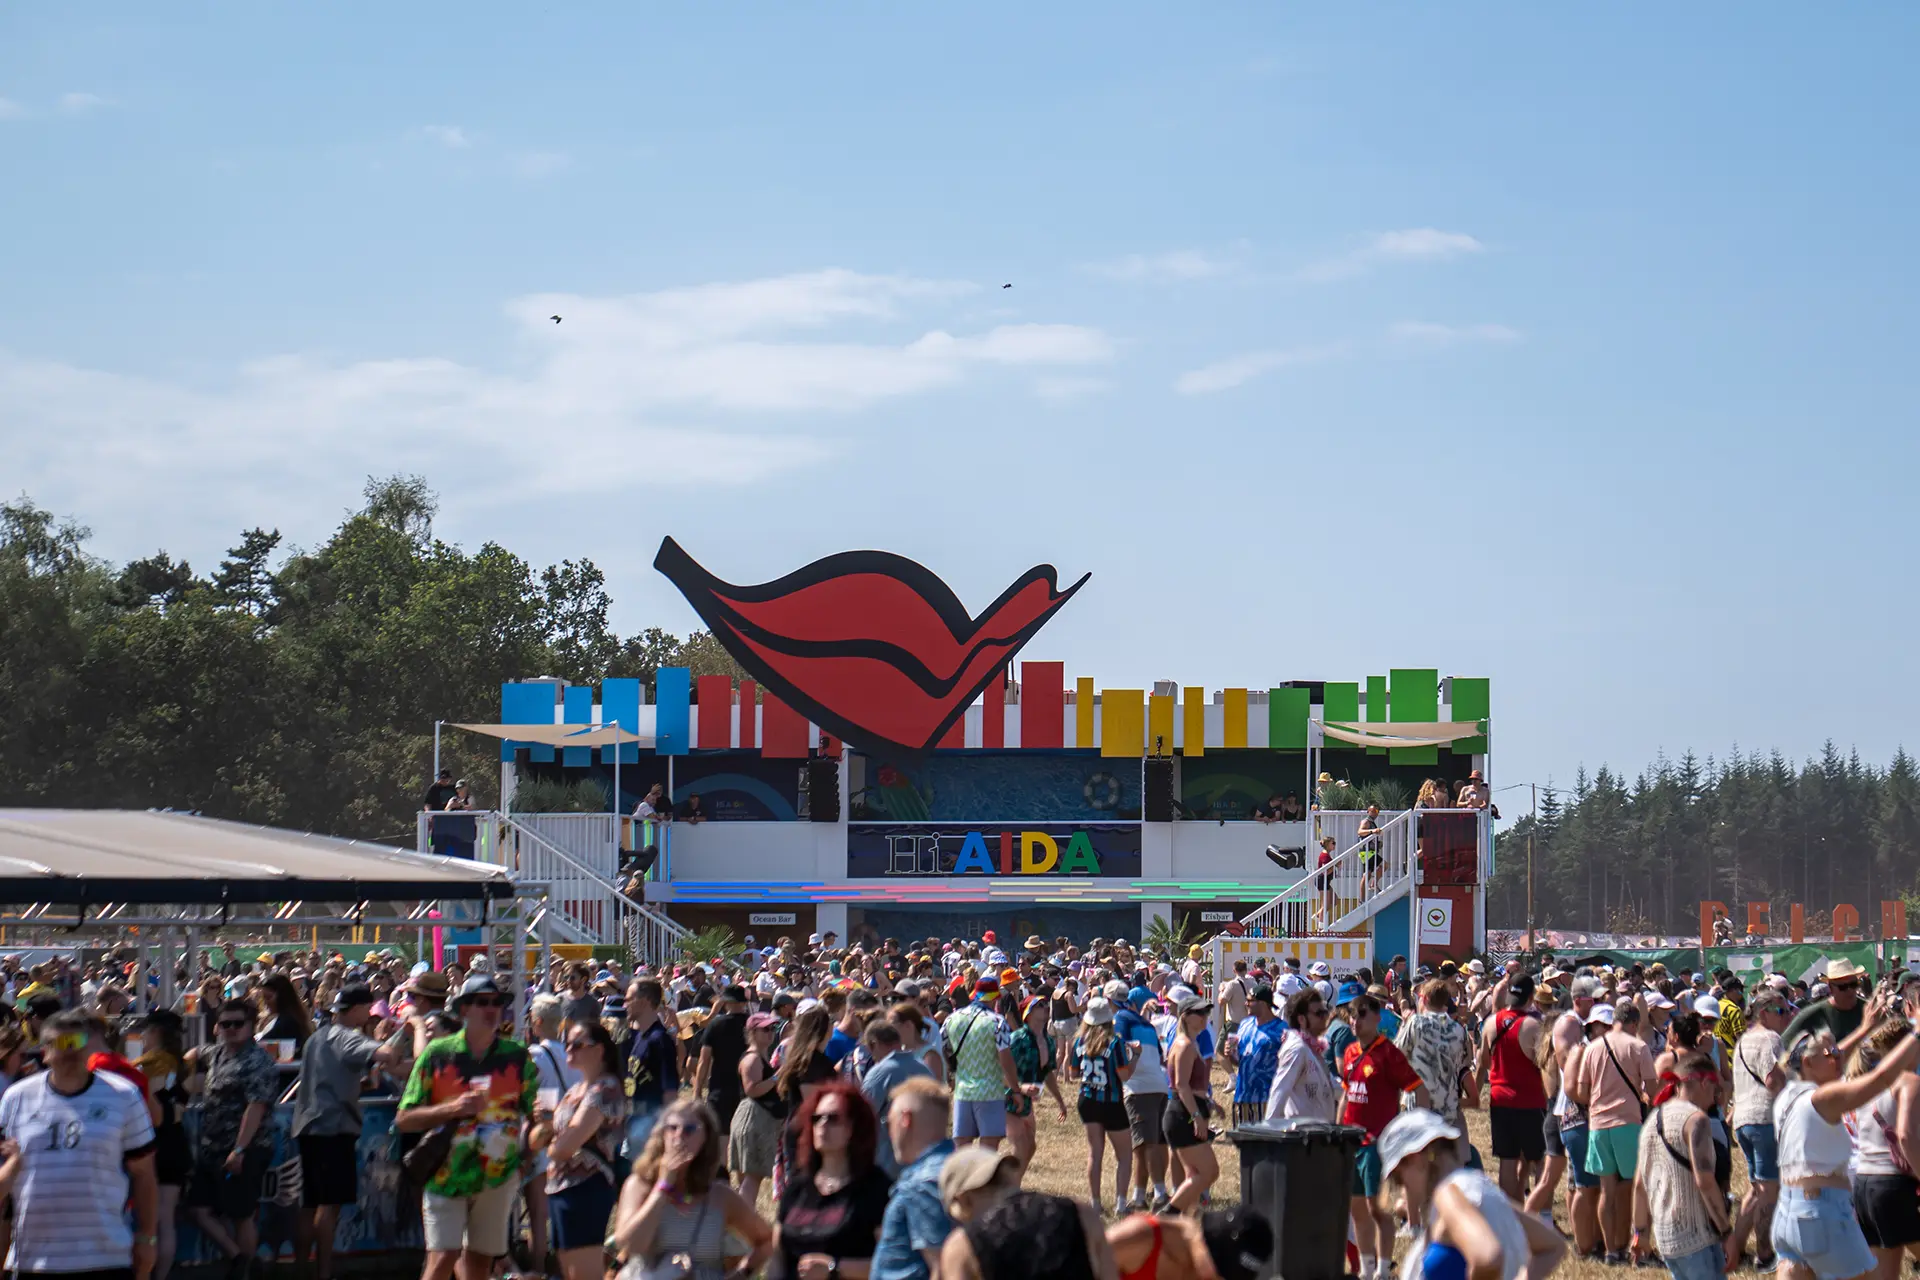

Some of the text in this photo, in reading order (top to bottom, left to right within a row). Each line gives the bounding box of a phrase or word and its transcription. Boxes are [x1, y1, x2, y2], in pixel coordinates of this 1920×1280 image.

[885, 831, 1101, 874] Hi AIDA
[753, 915, 776, 923] Ocean
[1252, 926, 1287, 938] AIDA
[1080, 1059, 1107, 1085] 25
[44, 1120, 81, 1150] 18
